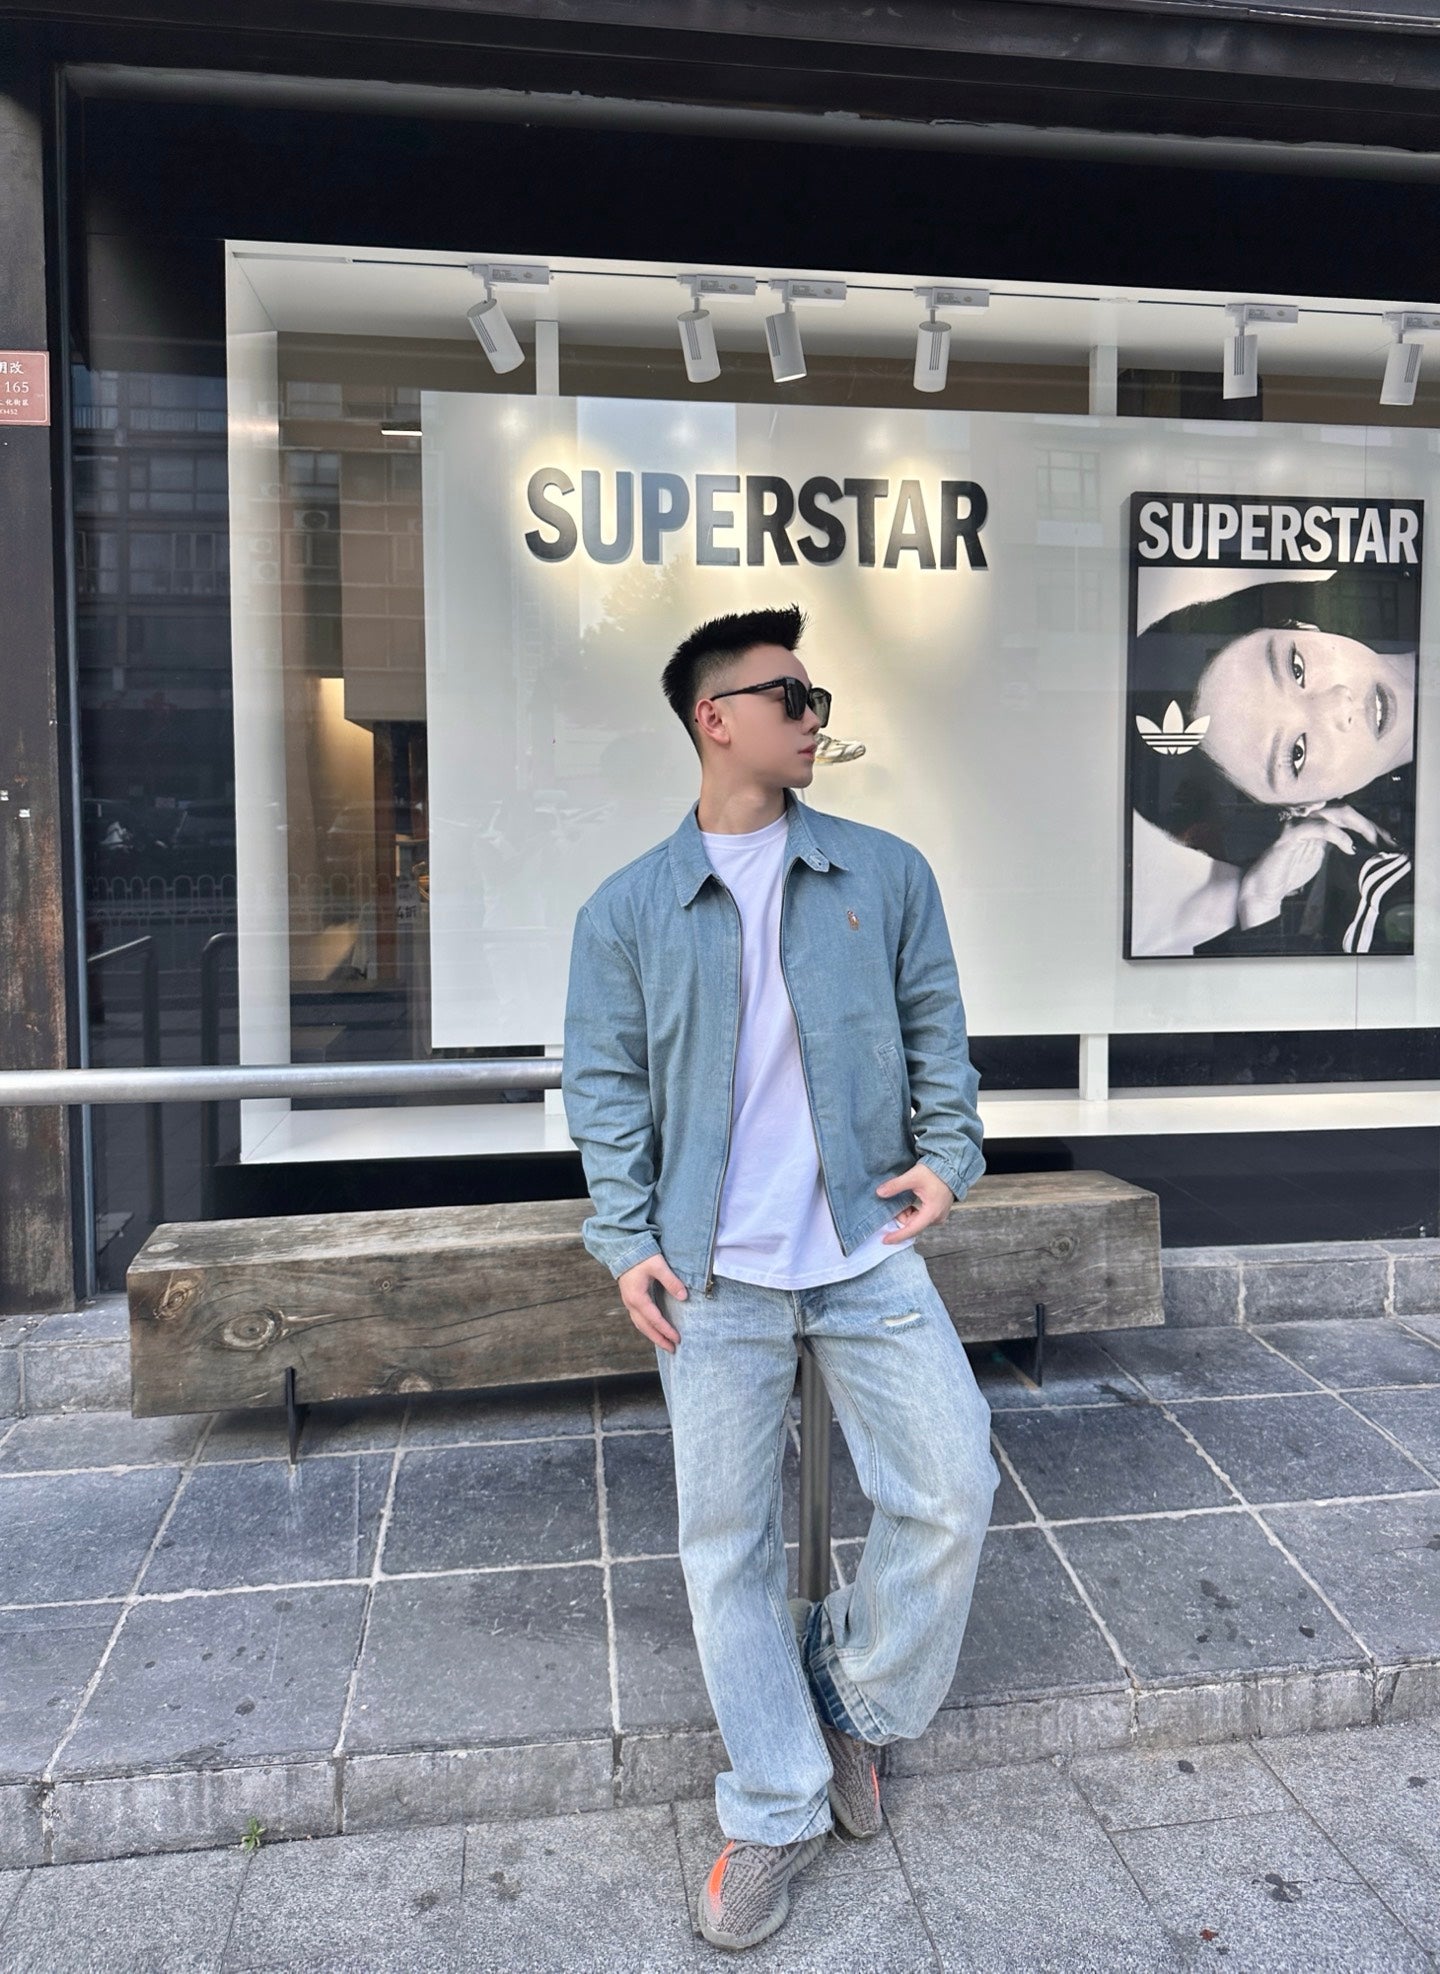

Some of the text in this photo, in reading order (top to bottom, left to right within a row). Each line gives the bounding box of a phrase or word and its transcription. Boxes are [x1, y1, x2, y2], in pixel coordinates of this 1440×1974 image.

[5, 381, 30, 393] 165
[525, 467, 988, 570] SUPERSTAR
[1138, 501, 1419, 563] SUPERSTAR
